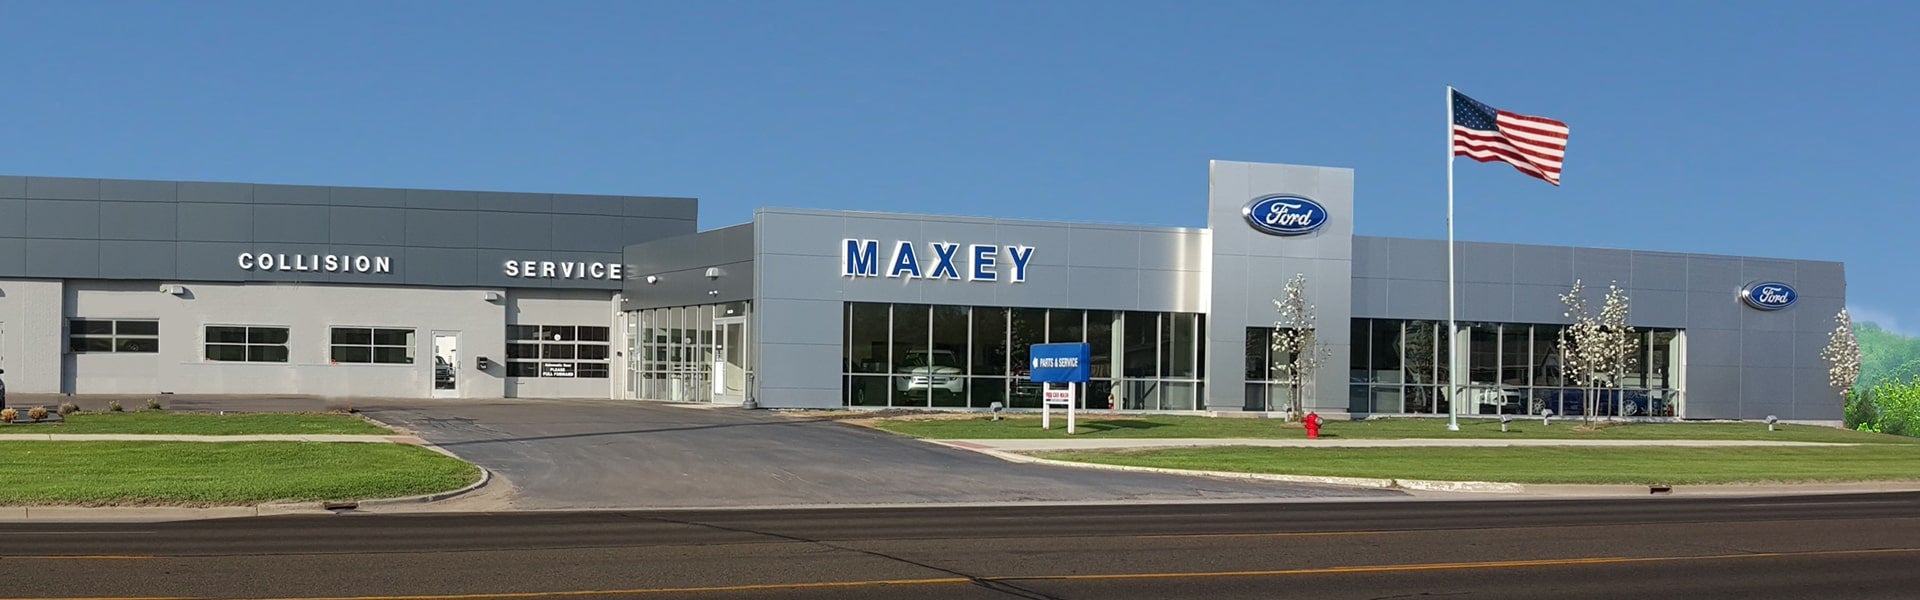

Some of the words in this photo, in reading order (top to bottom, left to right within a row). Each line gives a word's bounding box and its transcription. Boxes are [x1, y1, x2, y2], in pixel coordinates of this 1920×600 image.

[1266, 202, 1313, 226] Ford
[238, 252, 390, 273] COLLISION
[504, 260, 622, 279] SERVICE
[841, 238, 1036, 284] MAXEY
[1759, 286, 1789, 303] Ford
[1040, 357, 1054, 368] PARTS
[1059, 357, 1079, 368] SERVICE
